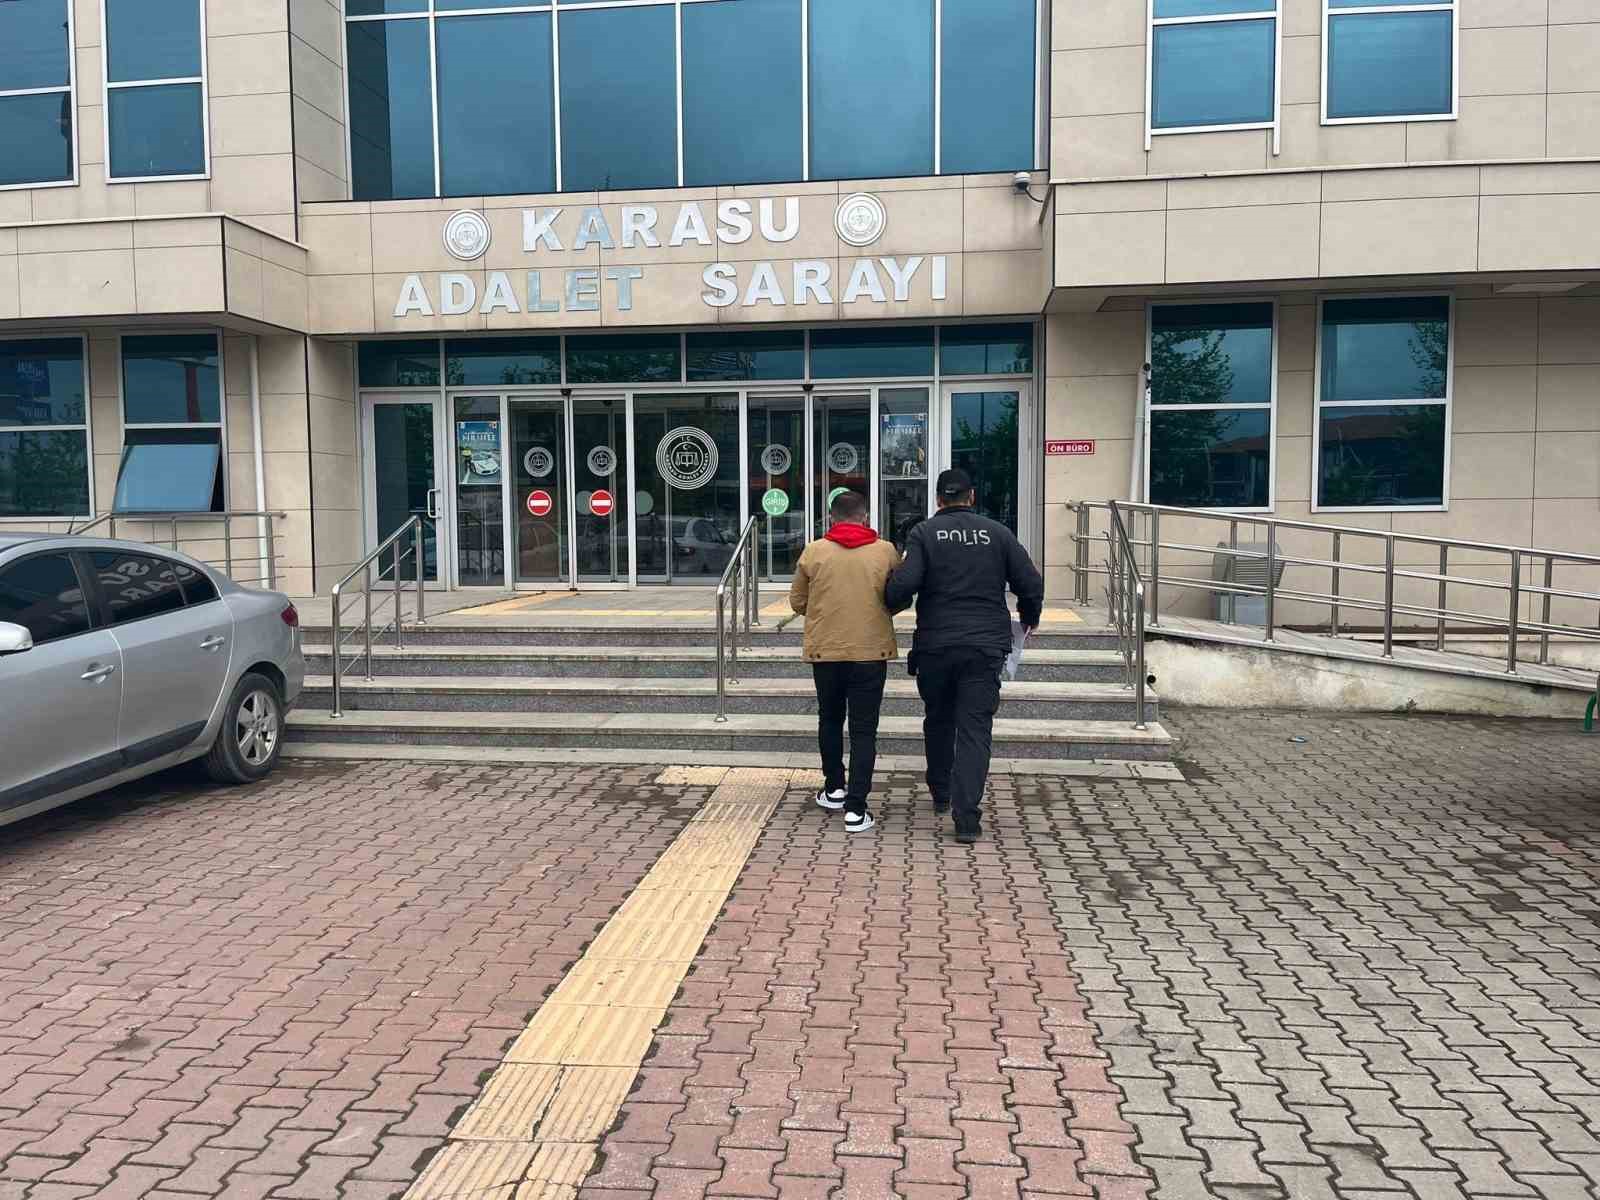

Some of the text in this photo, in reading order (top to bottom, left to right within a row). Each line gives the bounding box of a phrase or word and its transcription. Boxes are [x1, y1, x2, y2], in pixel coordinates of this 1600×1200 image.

[522, 196, 800, 252] KARASU
[392, 255, 949, 317] ADALET SARAYI
